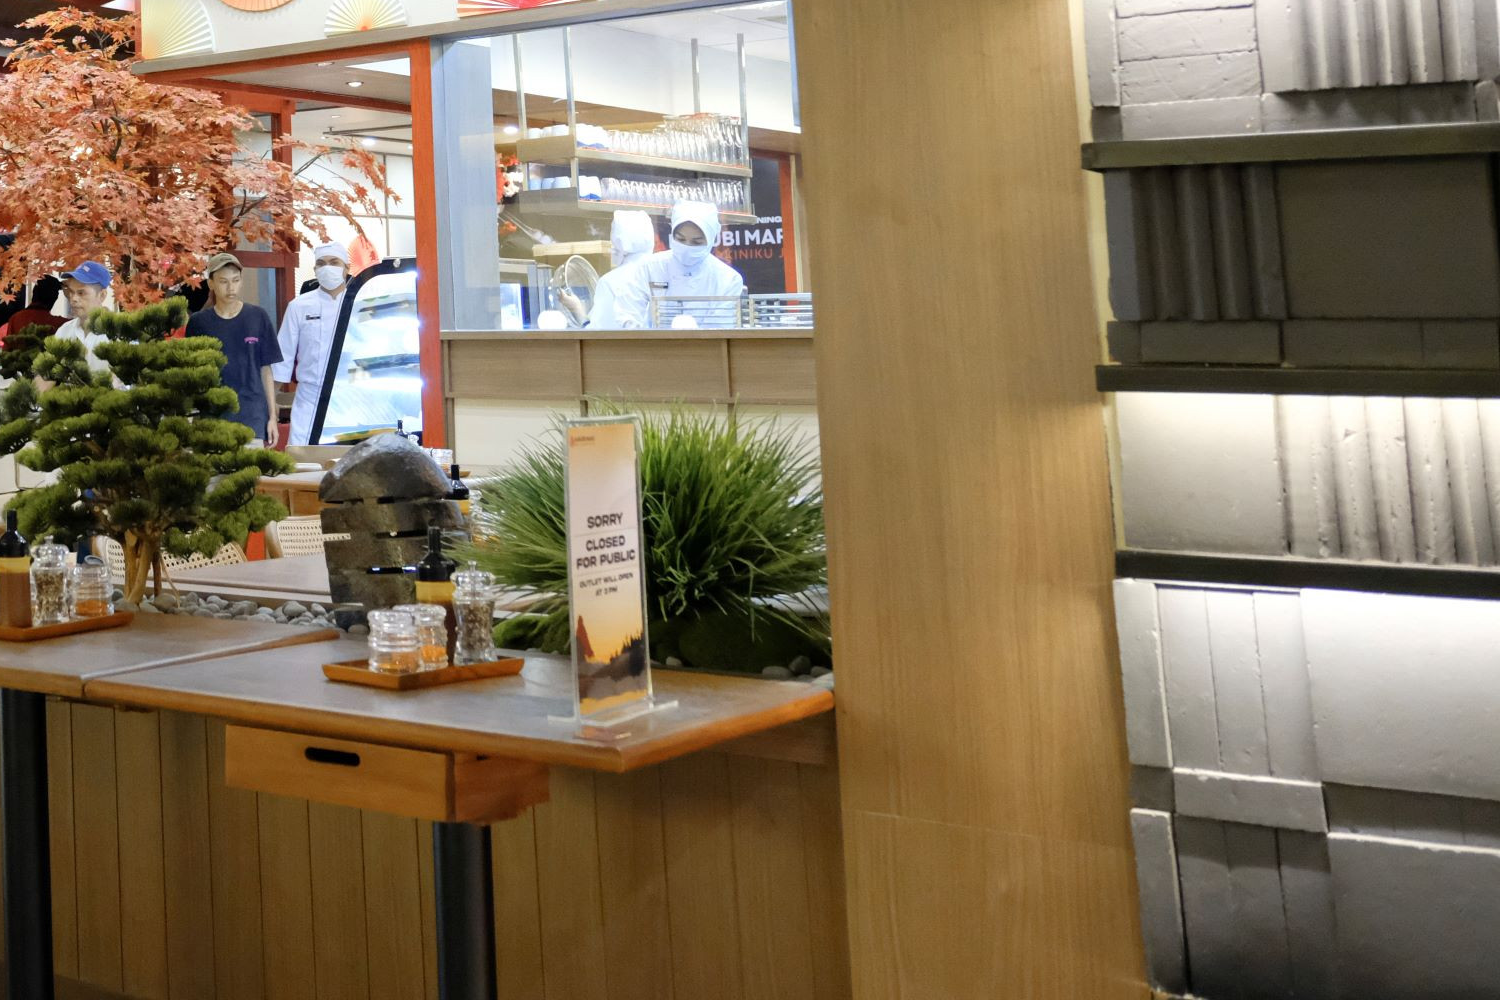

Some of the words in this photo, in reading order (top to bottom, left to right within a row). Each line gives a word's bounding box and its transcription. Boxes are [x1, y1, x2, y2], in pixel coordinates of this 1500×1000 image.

[587, 512, 623, 529] SORRY
[586, 535, 626, 552] CLOSED
[576, 556, 597, 570] FOR
[600, 549, 636, 566] PUBLIC
